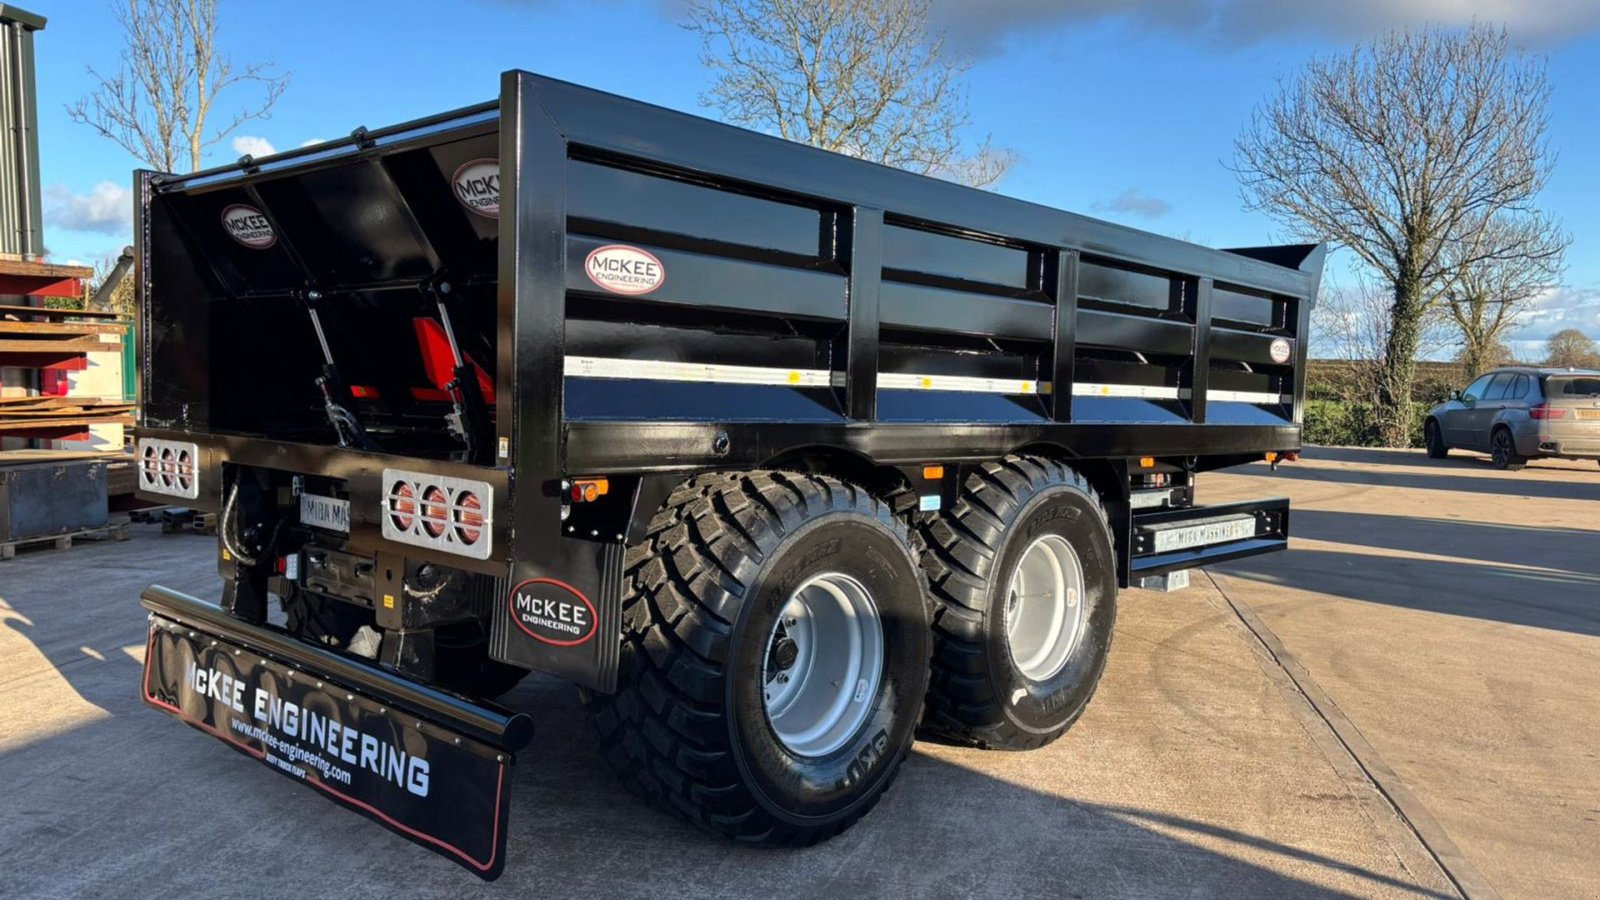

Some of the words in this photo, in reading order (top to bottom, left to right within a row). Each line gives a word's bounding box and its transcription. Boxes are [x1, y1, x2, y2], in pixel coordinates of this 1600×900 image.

[595, 272, 655, 286] ENGINEERING
[522, 613, 580, 635] ENGINEERING
[231, 717, 351, 785] www.mckee-engineering.com
[254, 687, 430, 798] ENGINEERING
